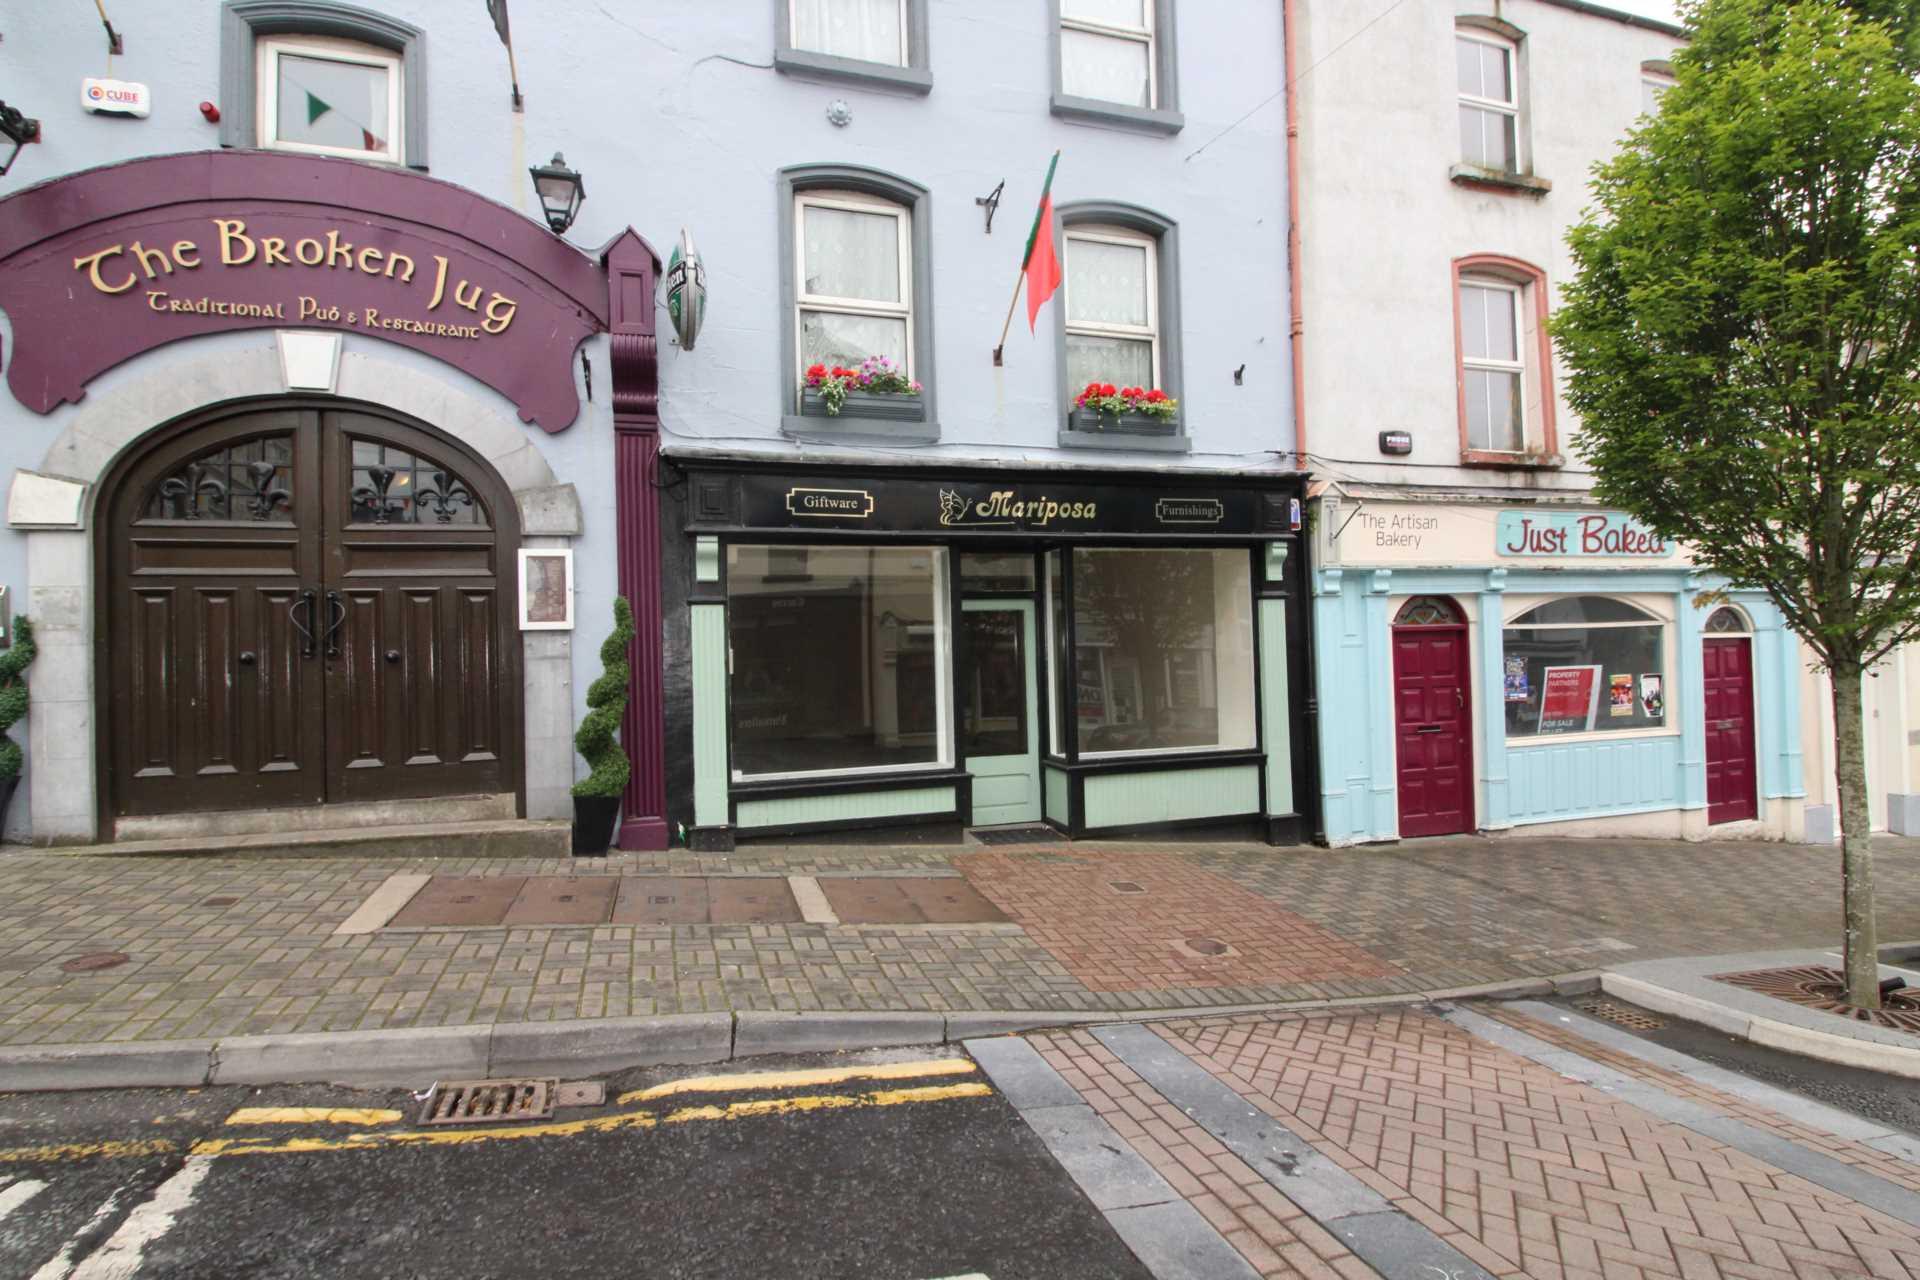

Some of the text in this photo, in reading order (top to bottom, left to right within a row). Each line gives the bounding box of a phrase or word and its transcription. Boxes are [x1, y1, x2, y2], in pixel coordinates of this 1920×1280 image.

[106, 90, 139, 101] CUBE
[74, 219, 518, 334] The Broken Jug
[146, 291, 285, 320] Traditional
[299, 296, 341, 321] Pub
[365, 308, 481, 340] Restaurant
[803, 495, 859, 509] Giftware
[976, 491, 1097, 525] Mariposa
[1162, 504, 1218, 518] Furnishings
[1360, 513, 1438, 529] The Artisan
[1376, 531, 1422, 549] Bakery
[1507, 519, 1567, 554] Just
[1548, 671, 1581, 679] PROPERTY
[1557, 719, 1574, 727] SALE
